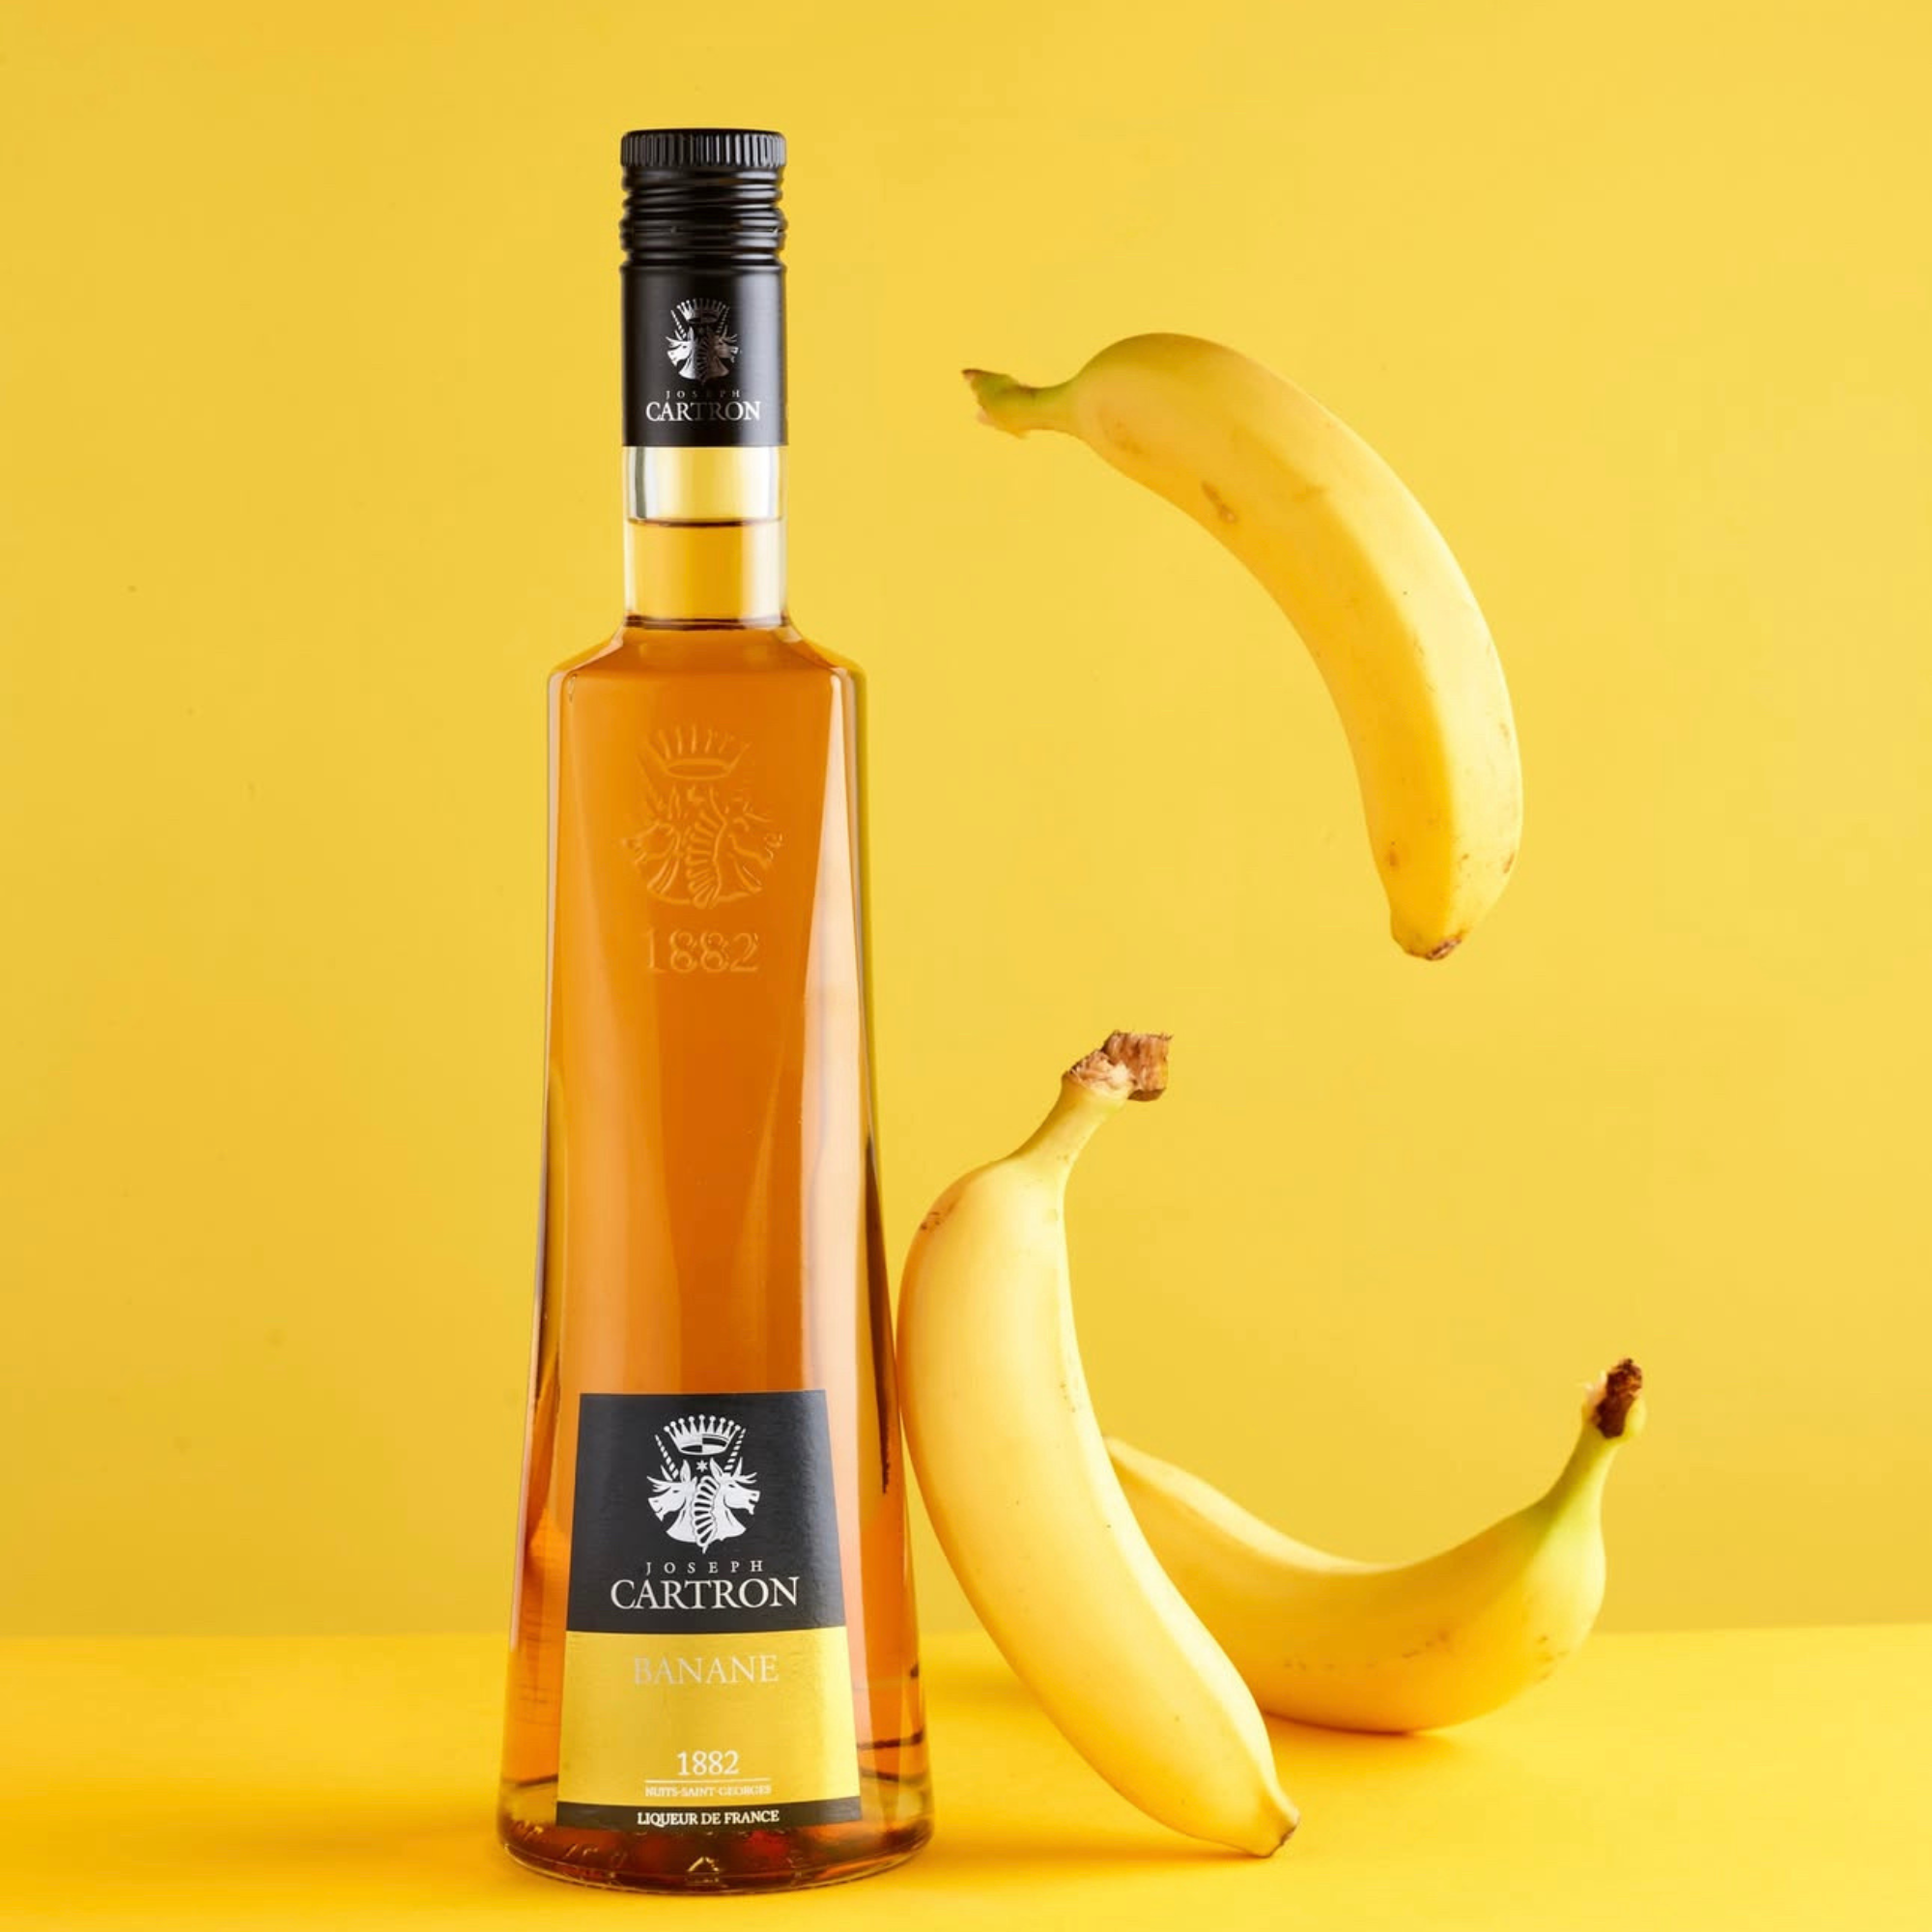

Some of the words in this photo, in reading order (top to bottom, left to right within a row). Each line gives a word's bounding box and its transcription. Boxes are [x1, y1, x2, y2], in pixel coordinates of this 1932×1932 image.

[645, 401, 761, 421] CARTRON
[643, 927, 759, 973] 1882
[645, 1560, 764, 1576] JOSEPH
[610, 1577, 800, 1609] CARTRON
[633, 1655, 780, 1685] BANANE
[676, 1750, 740, 1776] 1882
[644, 1784, 772, 1798] NUITS-SAINT-GEORGES
[637, 1811, 698, 1827] LIQUEUR
[700, 1812, 722, 1825] DE
[724, 1809, 780, 1825] FRANCE
